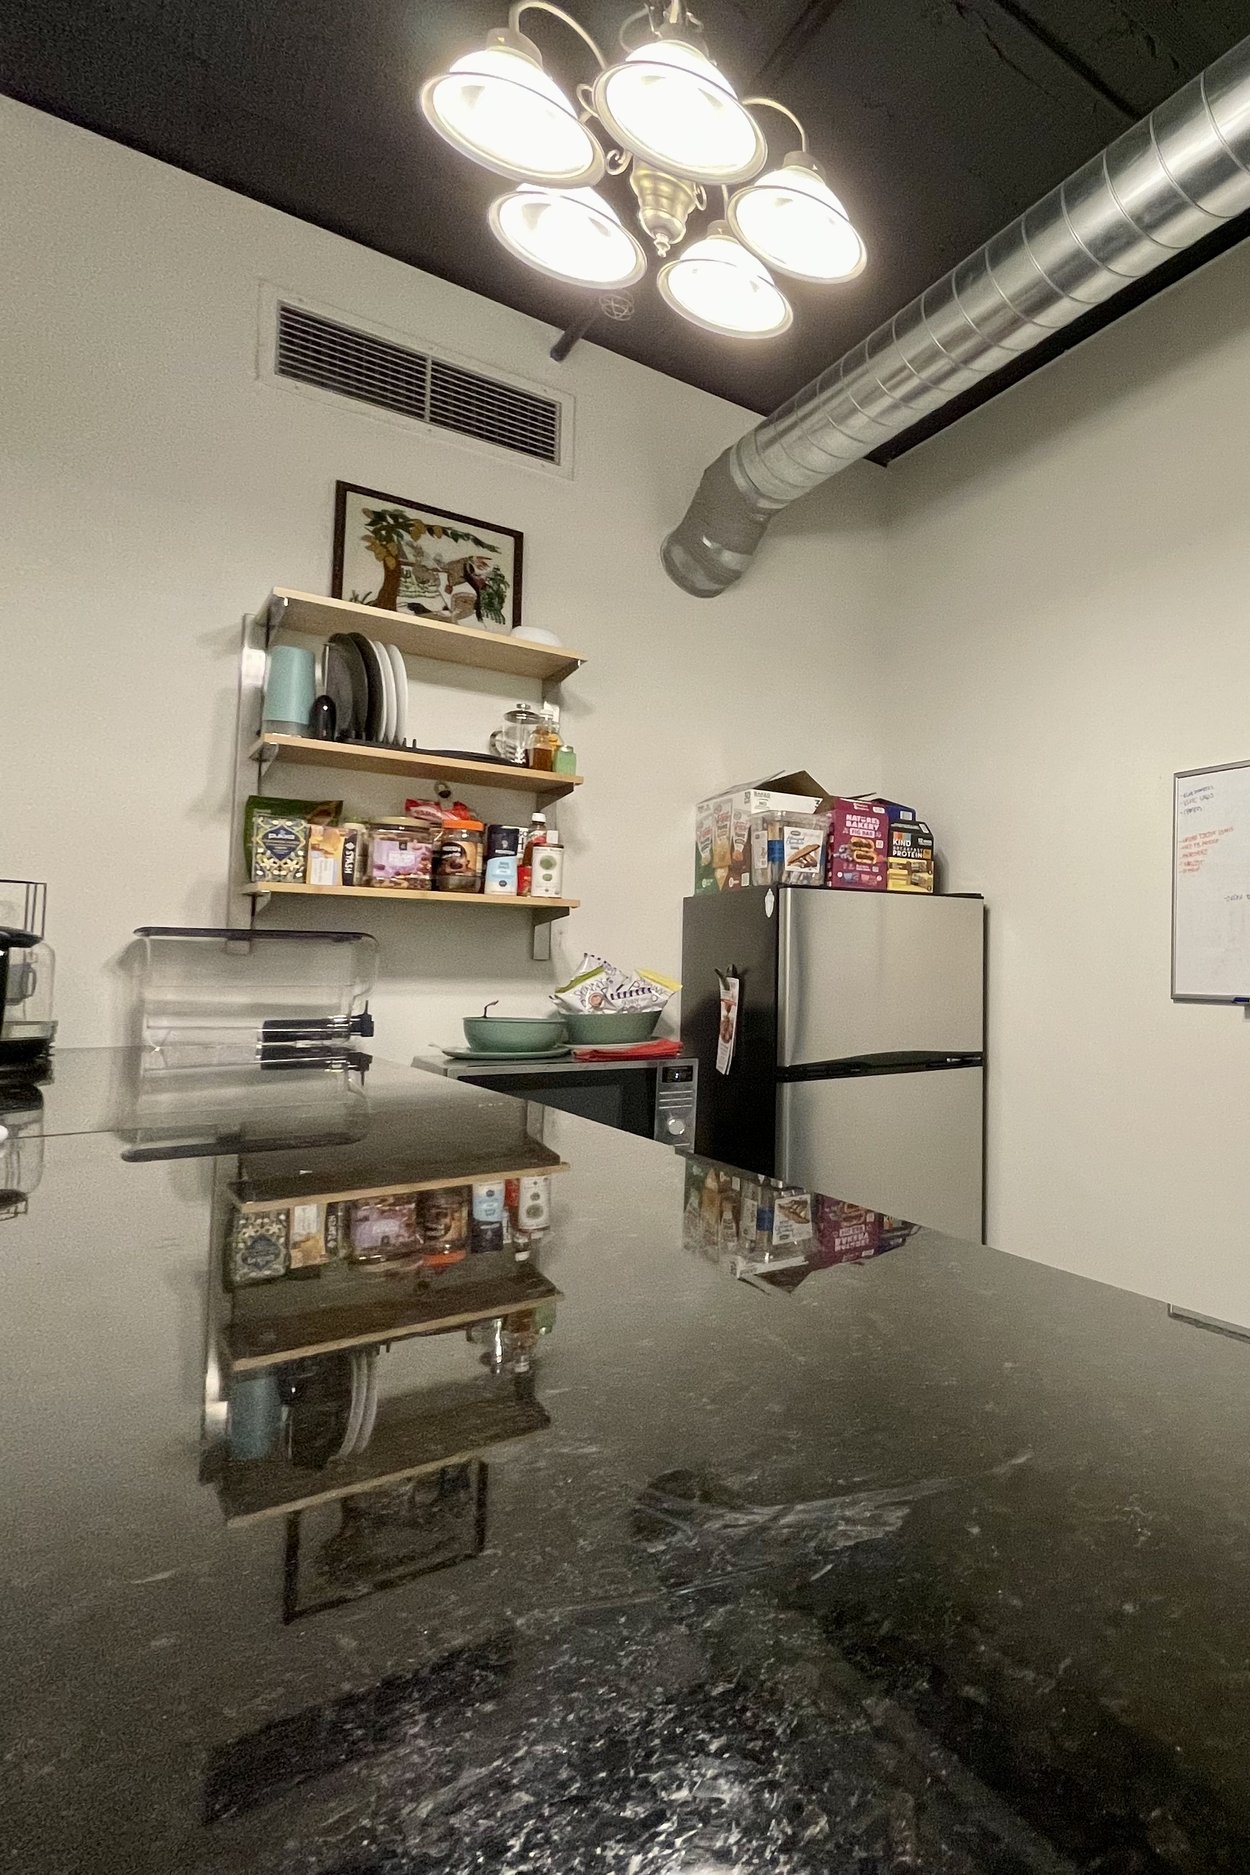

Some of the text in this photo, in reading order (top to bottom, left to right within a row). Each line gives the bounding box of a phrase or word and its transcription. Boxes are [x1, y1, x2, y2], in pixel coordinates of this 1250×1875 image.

[845, 820, 880, 831] BAKERY
[892, 838, 912, 848] KIND
[892, 849, 923, 859] PROTEIN
[344, 850, 355, 874] STASH
